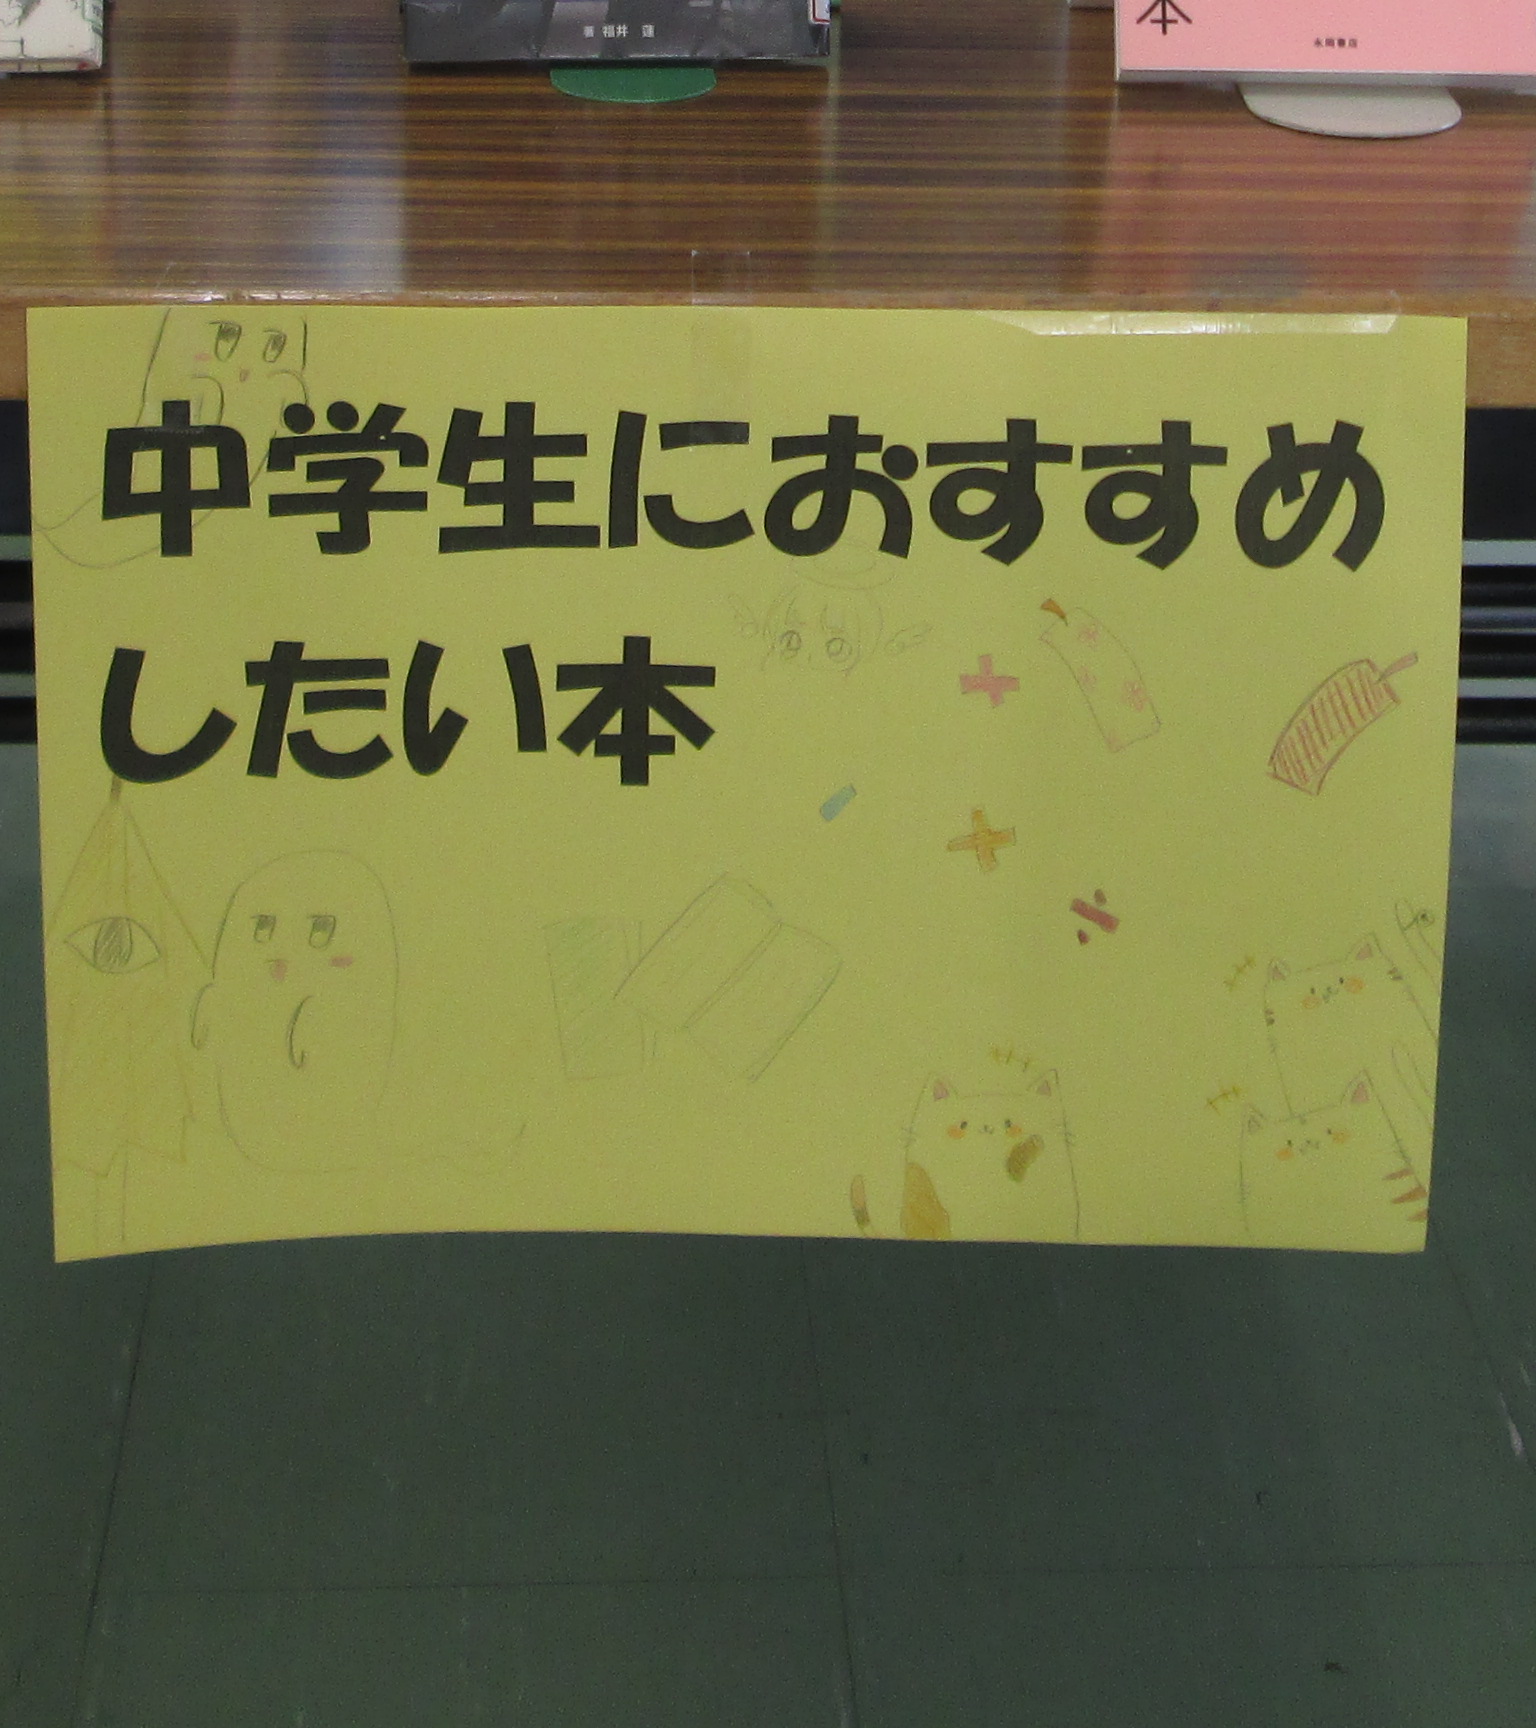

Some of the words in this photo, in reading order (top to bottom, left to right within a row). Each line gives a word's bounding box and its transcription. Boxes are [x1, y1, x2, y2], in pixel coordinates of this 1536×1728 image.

[101, 399, 1386, 572] 中学生におすすめ
[100, 634, 716, 786] したい本
